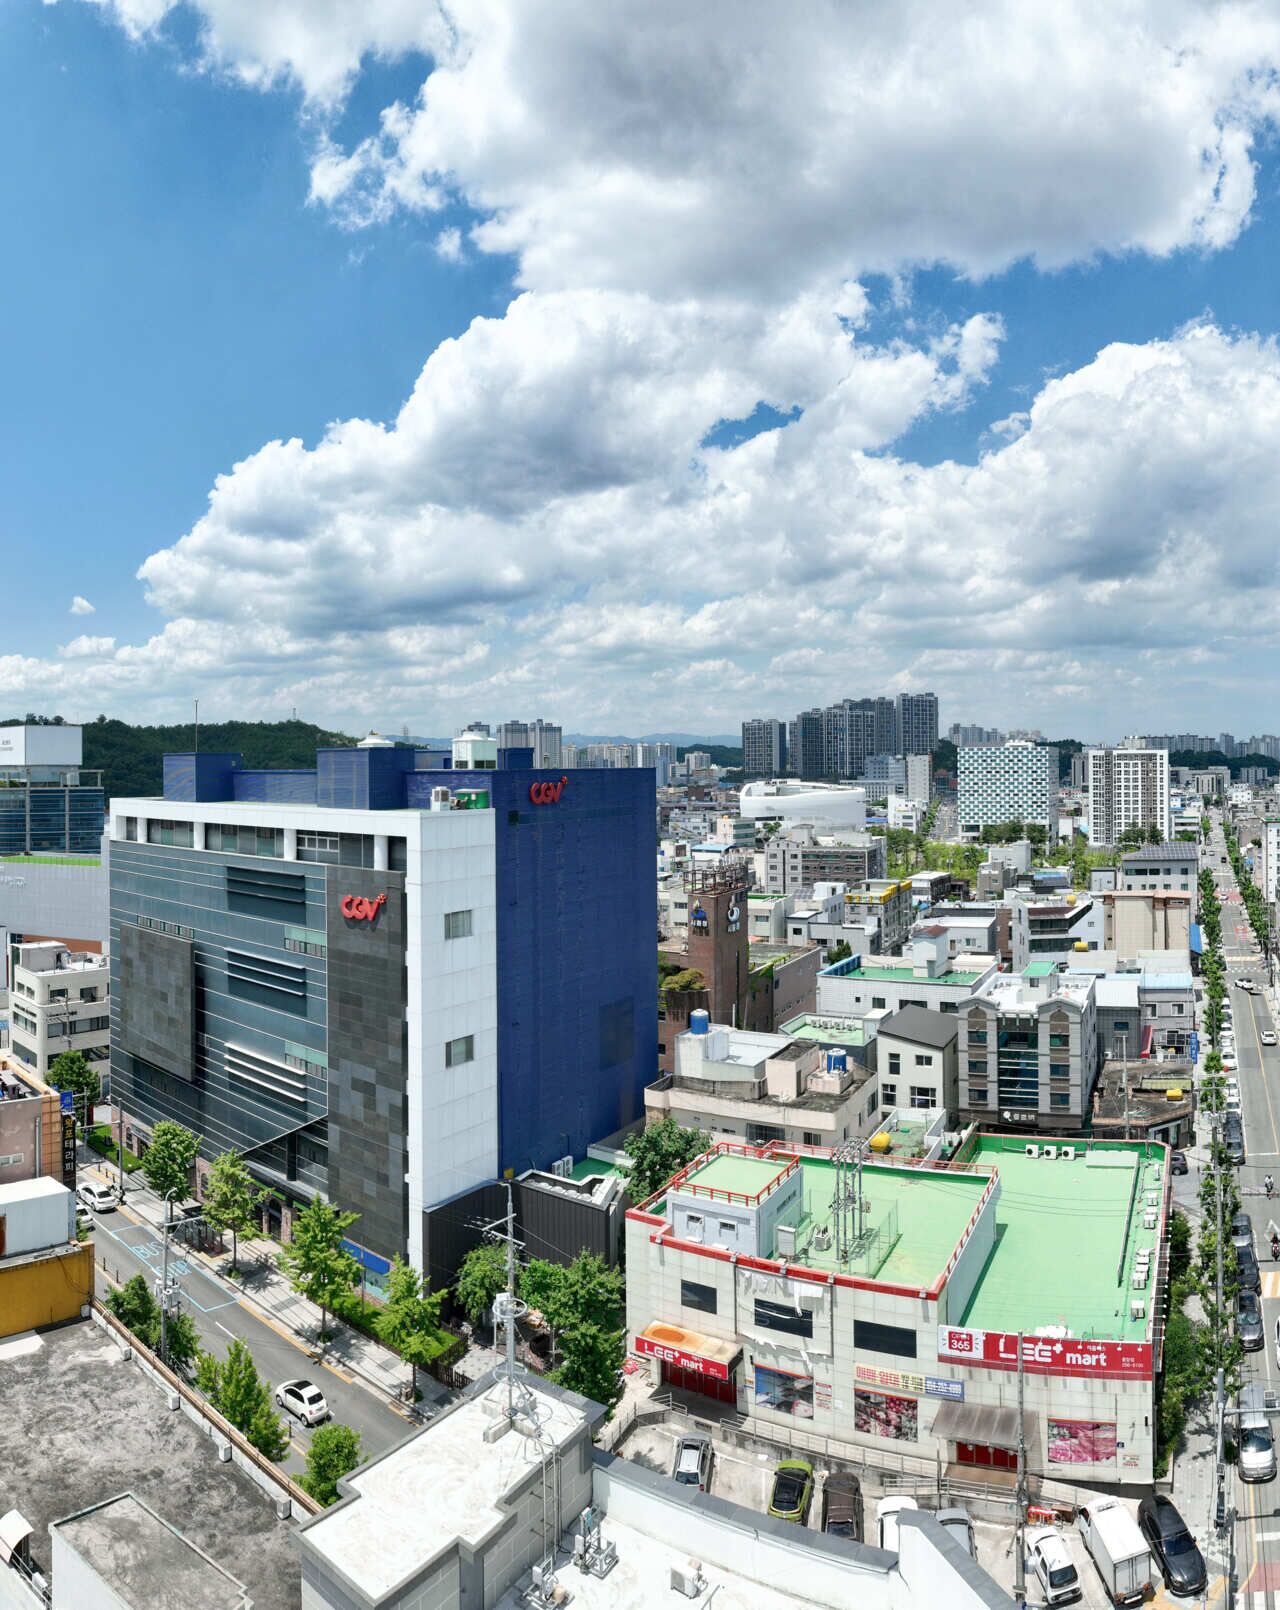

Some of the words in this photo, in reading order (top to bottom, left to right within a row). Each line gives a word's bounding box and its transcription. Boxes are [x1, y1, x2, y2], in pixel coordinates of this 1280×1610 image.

[530, 779, 566, 804] CGV
[340, 893, 385, 921] CGV
[951, 1340, 970, 1351] 365
[680, 1358, 704, 1372] mart
[1065, 1352, 1107, 1367] mart
